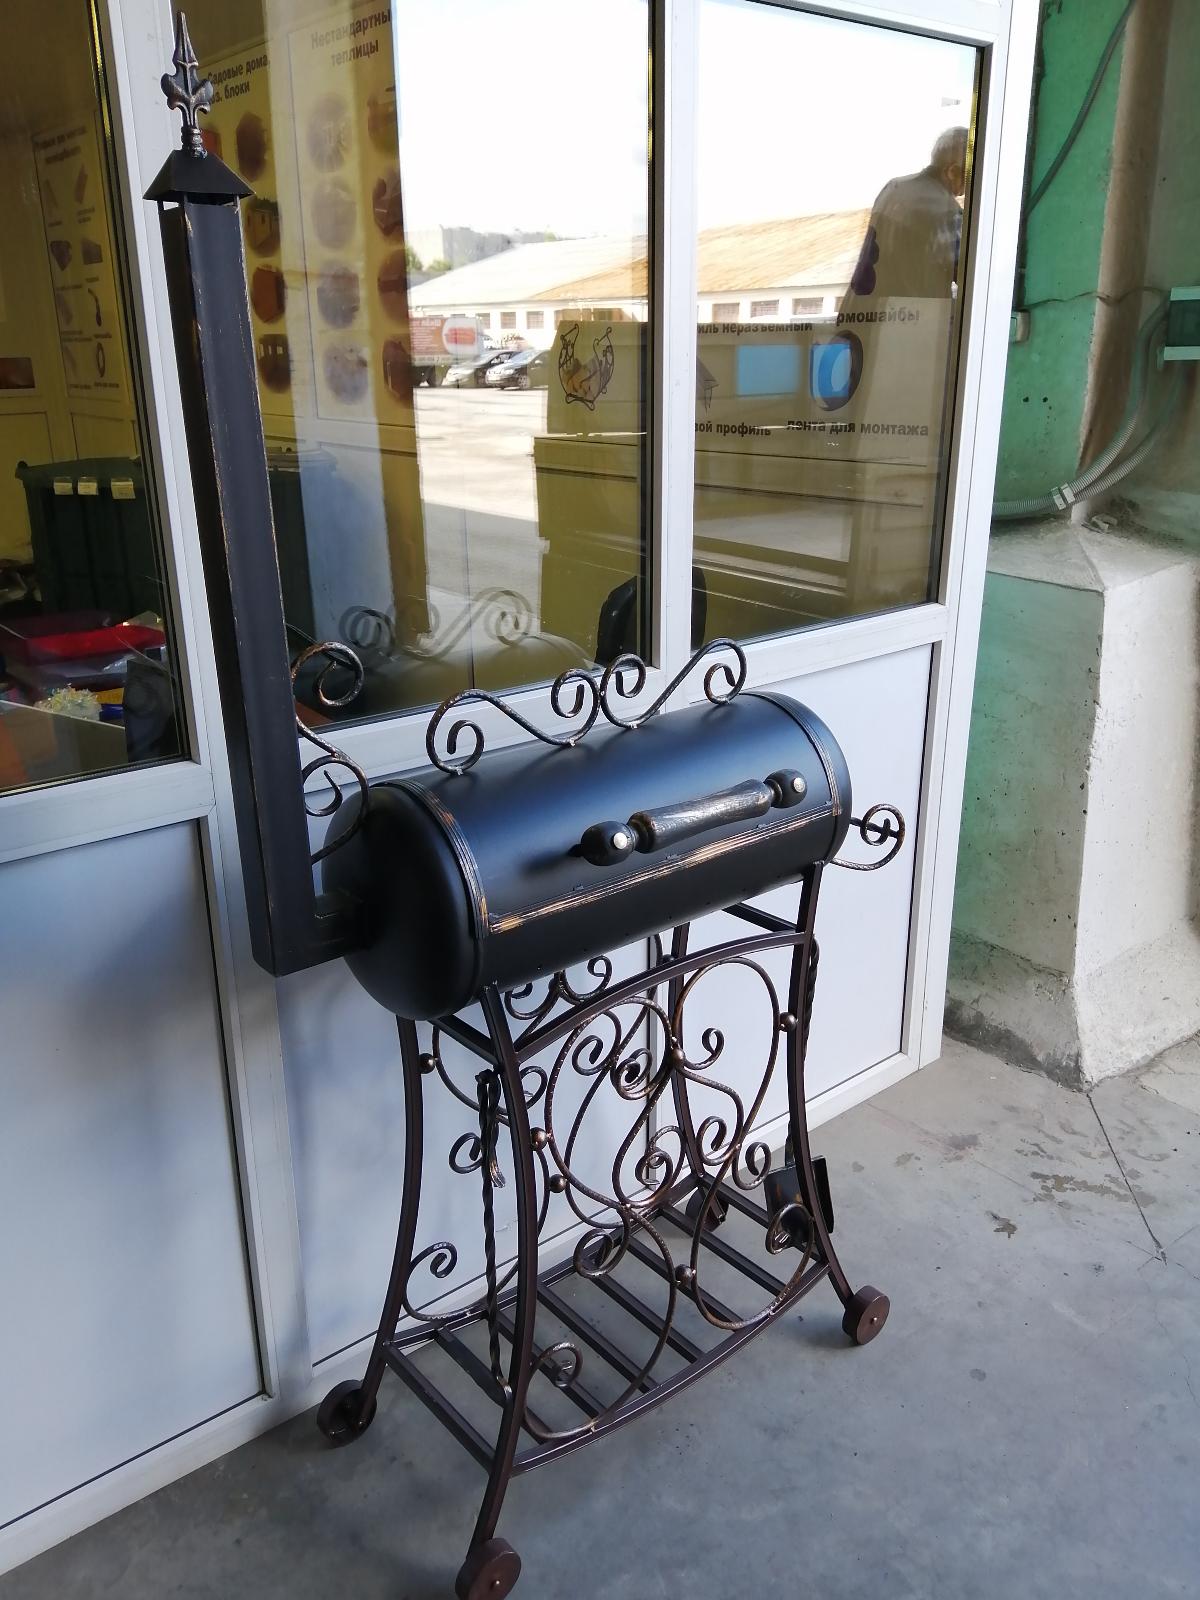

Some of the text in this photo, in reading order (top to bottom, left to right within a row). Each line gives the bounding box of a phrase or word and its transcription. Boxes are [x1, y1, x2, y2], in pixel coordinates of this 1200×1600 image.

[311, 9, 391, 49] Нестандартны
[331, 40, 379, 66] теплицы
[207, 64, 244, 85] Садовые
[224, 81, 250, 99] блоки
[836, 306, 920, 326] рмошайбы
[697, 323, 719, 334] иль
[716, 421, 772, 437] профиль
[787, 420, 929, 436] лента для монтажа
